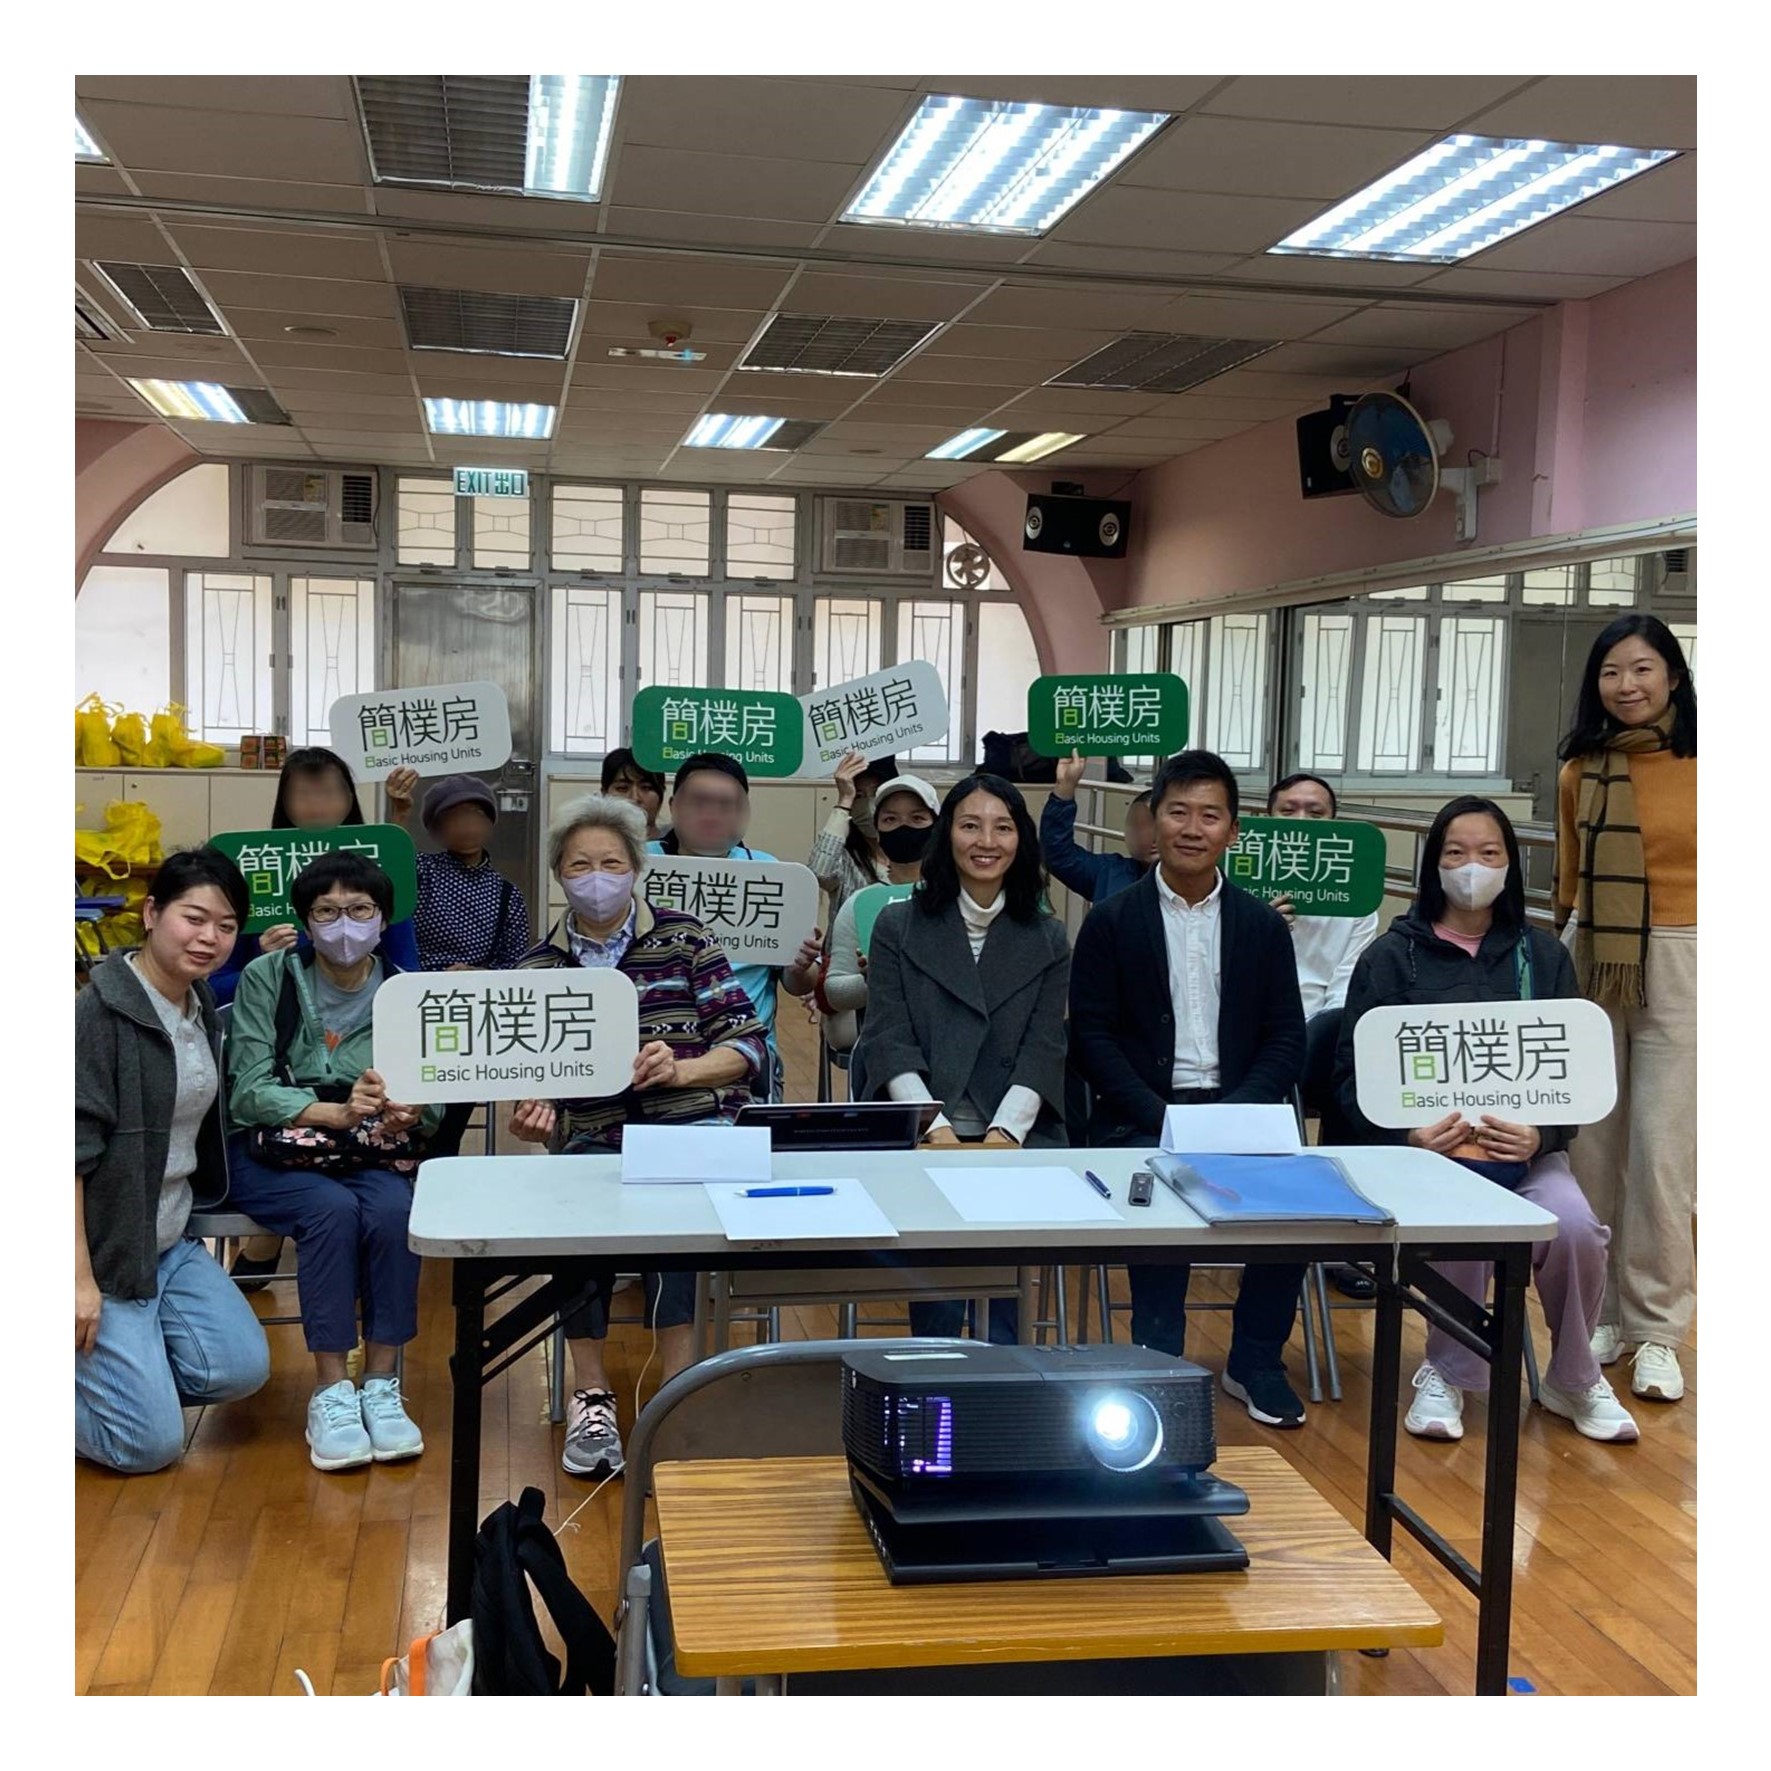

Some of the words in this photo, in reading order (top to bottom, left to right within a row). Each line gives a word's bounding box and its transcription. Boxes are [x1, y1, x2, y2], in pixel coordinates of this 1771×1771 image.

[457, 471, 492, 493] EXIT
[495, 472, 524, 495] 出口
[808, 678, 918, 747] 簡樸房
[1053, 684, 1162, 729] 簡樸房
[357, 695, 479, 752] 簡樸房
[661, 697, 777, 746] 簡樸房
[820, 747, 849, 762] Basic
[851, 733, 894, 751] Housing
[895, 723, 924, 739] Units
[1055, 732, 1085, 744] Basic
[1087, 733, 1130, 746] Housing
[1132, 732, 1160, 743] Units
[365, 755, 398, 769] Basic
[401, 751, 448, 766] Housing
[450, 746, 482, 759] Units
[745, 751, 775, 763] Units
[1317, 888, 1350, 902] Units
[744, 934, 779, 949] Units
[417, 986, 596, 1058] 簡樸房
[1395, 1016, 1570, 1085] 簡樸房
[421, 1065, 471, 1083] Basic
[475, 1063, 545, 1082] Housing
[550, 1061, 594, 1078] Units
[1401, 1091, 1449, 1108] Basic
[1453, 1090, 1521, 1109] Housing
[1526, 1089, 1571, 1105] Units
